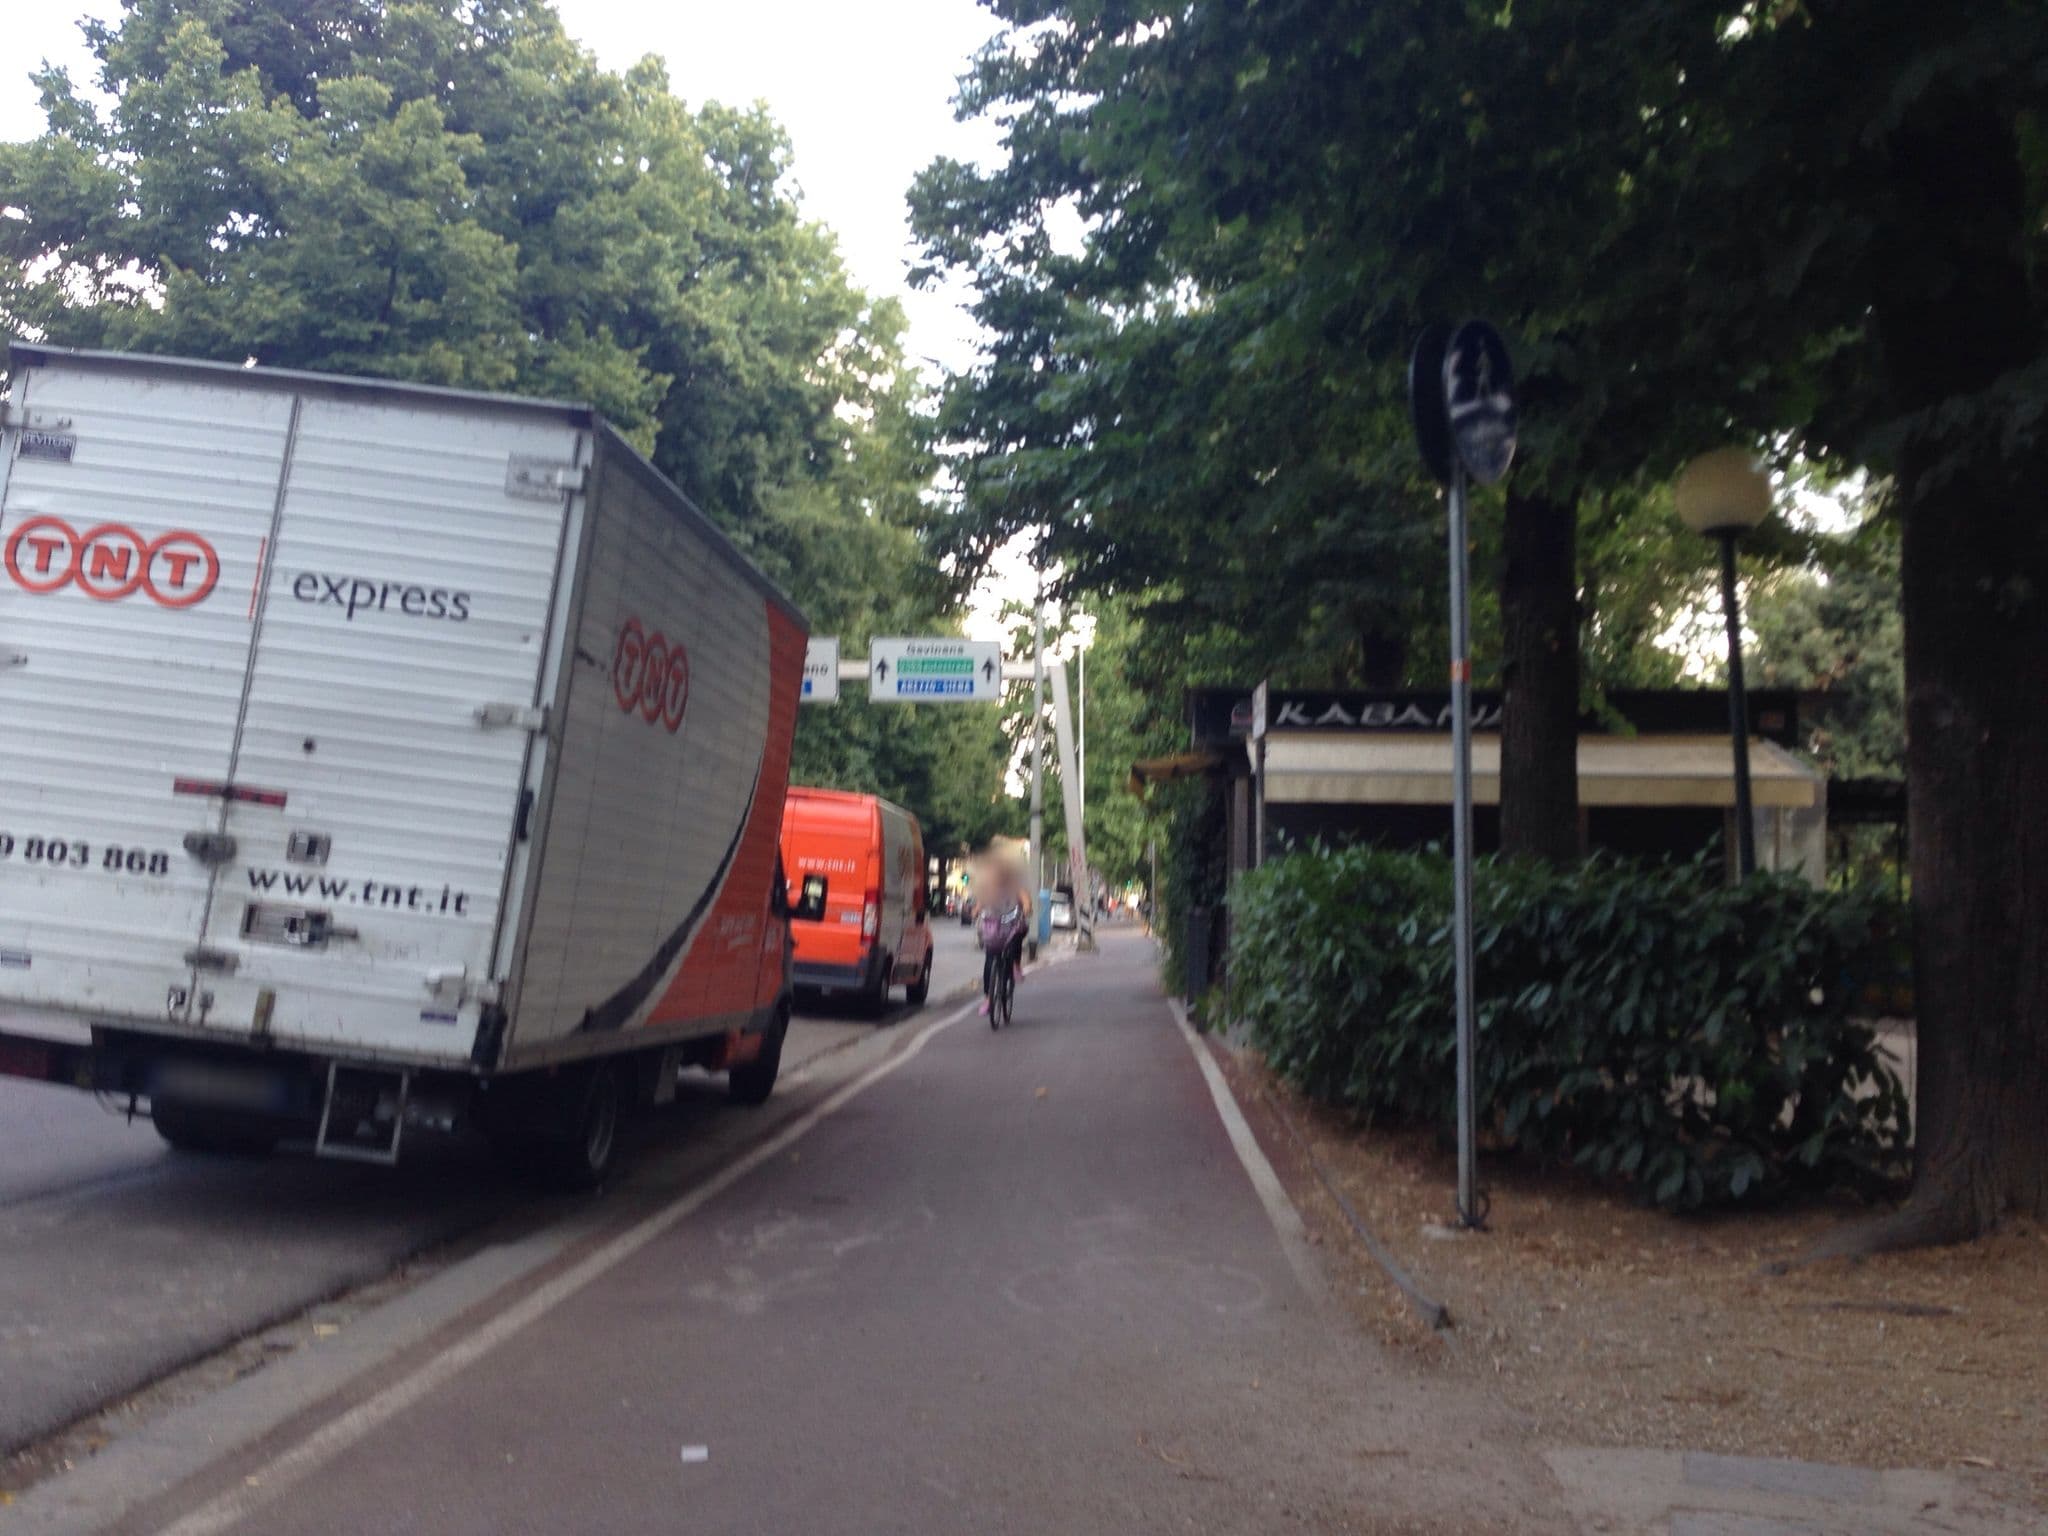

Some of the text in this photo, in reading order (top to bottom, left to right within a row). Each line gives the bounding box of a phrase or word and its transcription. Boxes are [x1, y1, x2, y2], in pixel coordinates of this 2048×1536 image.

[23, 532, 472, 621] TNT express
[621, 636, 686, 712] TNT
[24, 834, 90, 868] 803
[102, 844, 170, 877] 868
[247, 866, 469, 917] www.tnt.it
